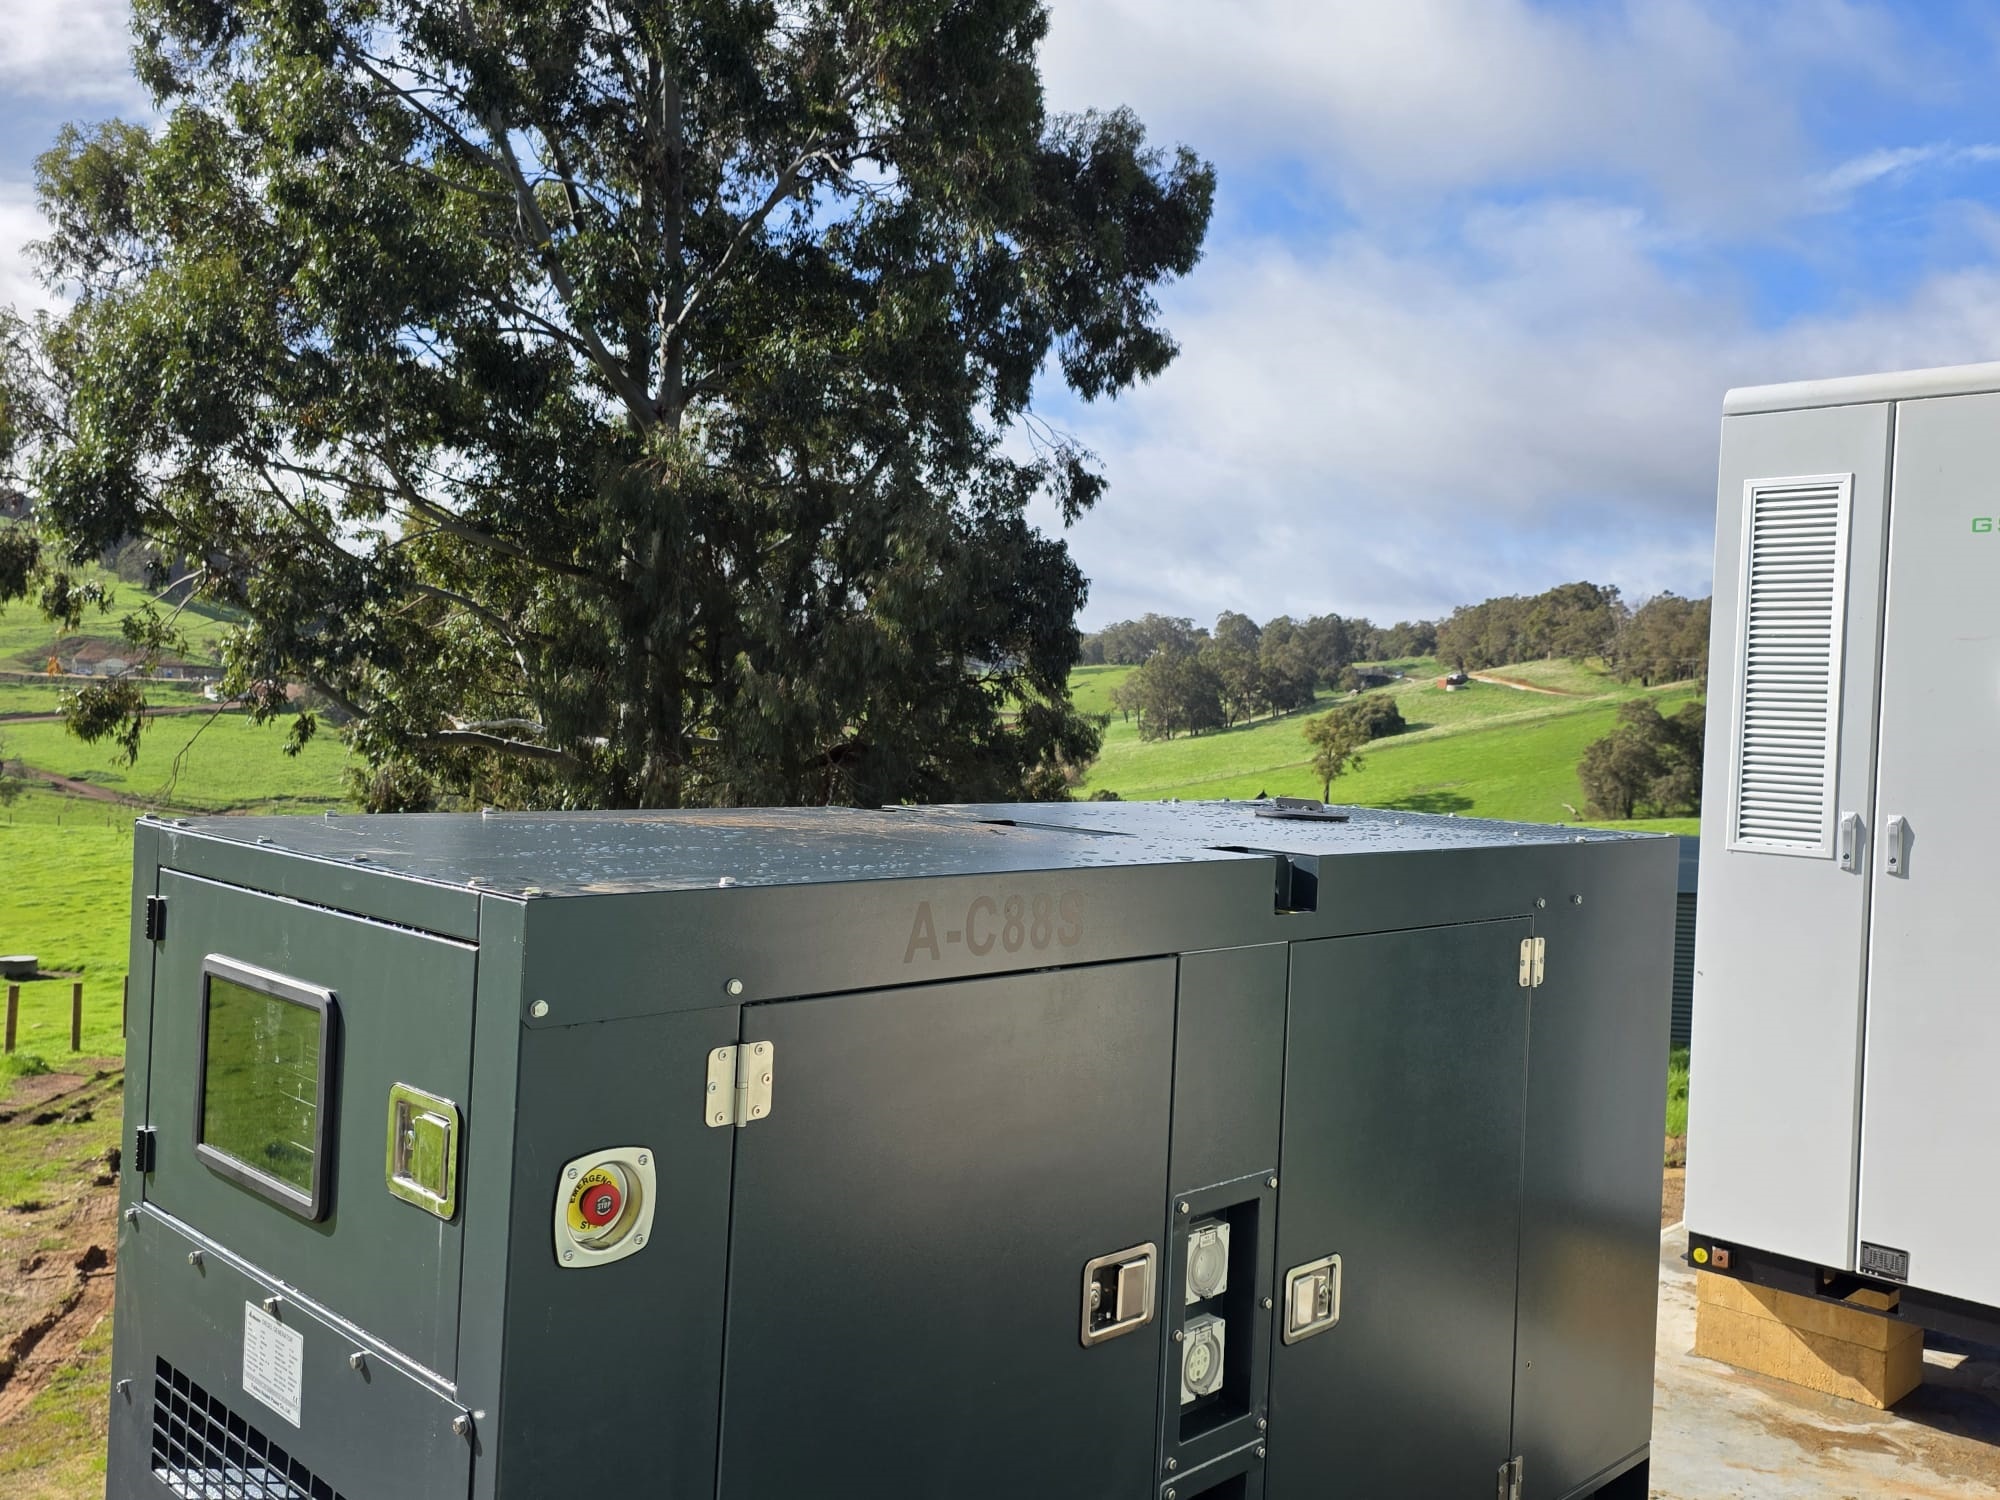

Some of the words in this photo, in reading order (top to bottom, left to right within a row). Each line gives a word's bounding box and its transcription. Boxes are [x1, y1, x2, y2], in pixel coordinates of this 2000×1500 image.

[1971, 517, 2000, 533] G
[903, 891, 1085, 964] A-C88S
[569, 1174, 612, 1204] EMERGEN
[597, 1200, 612, 1210] STOP
